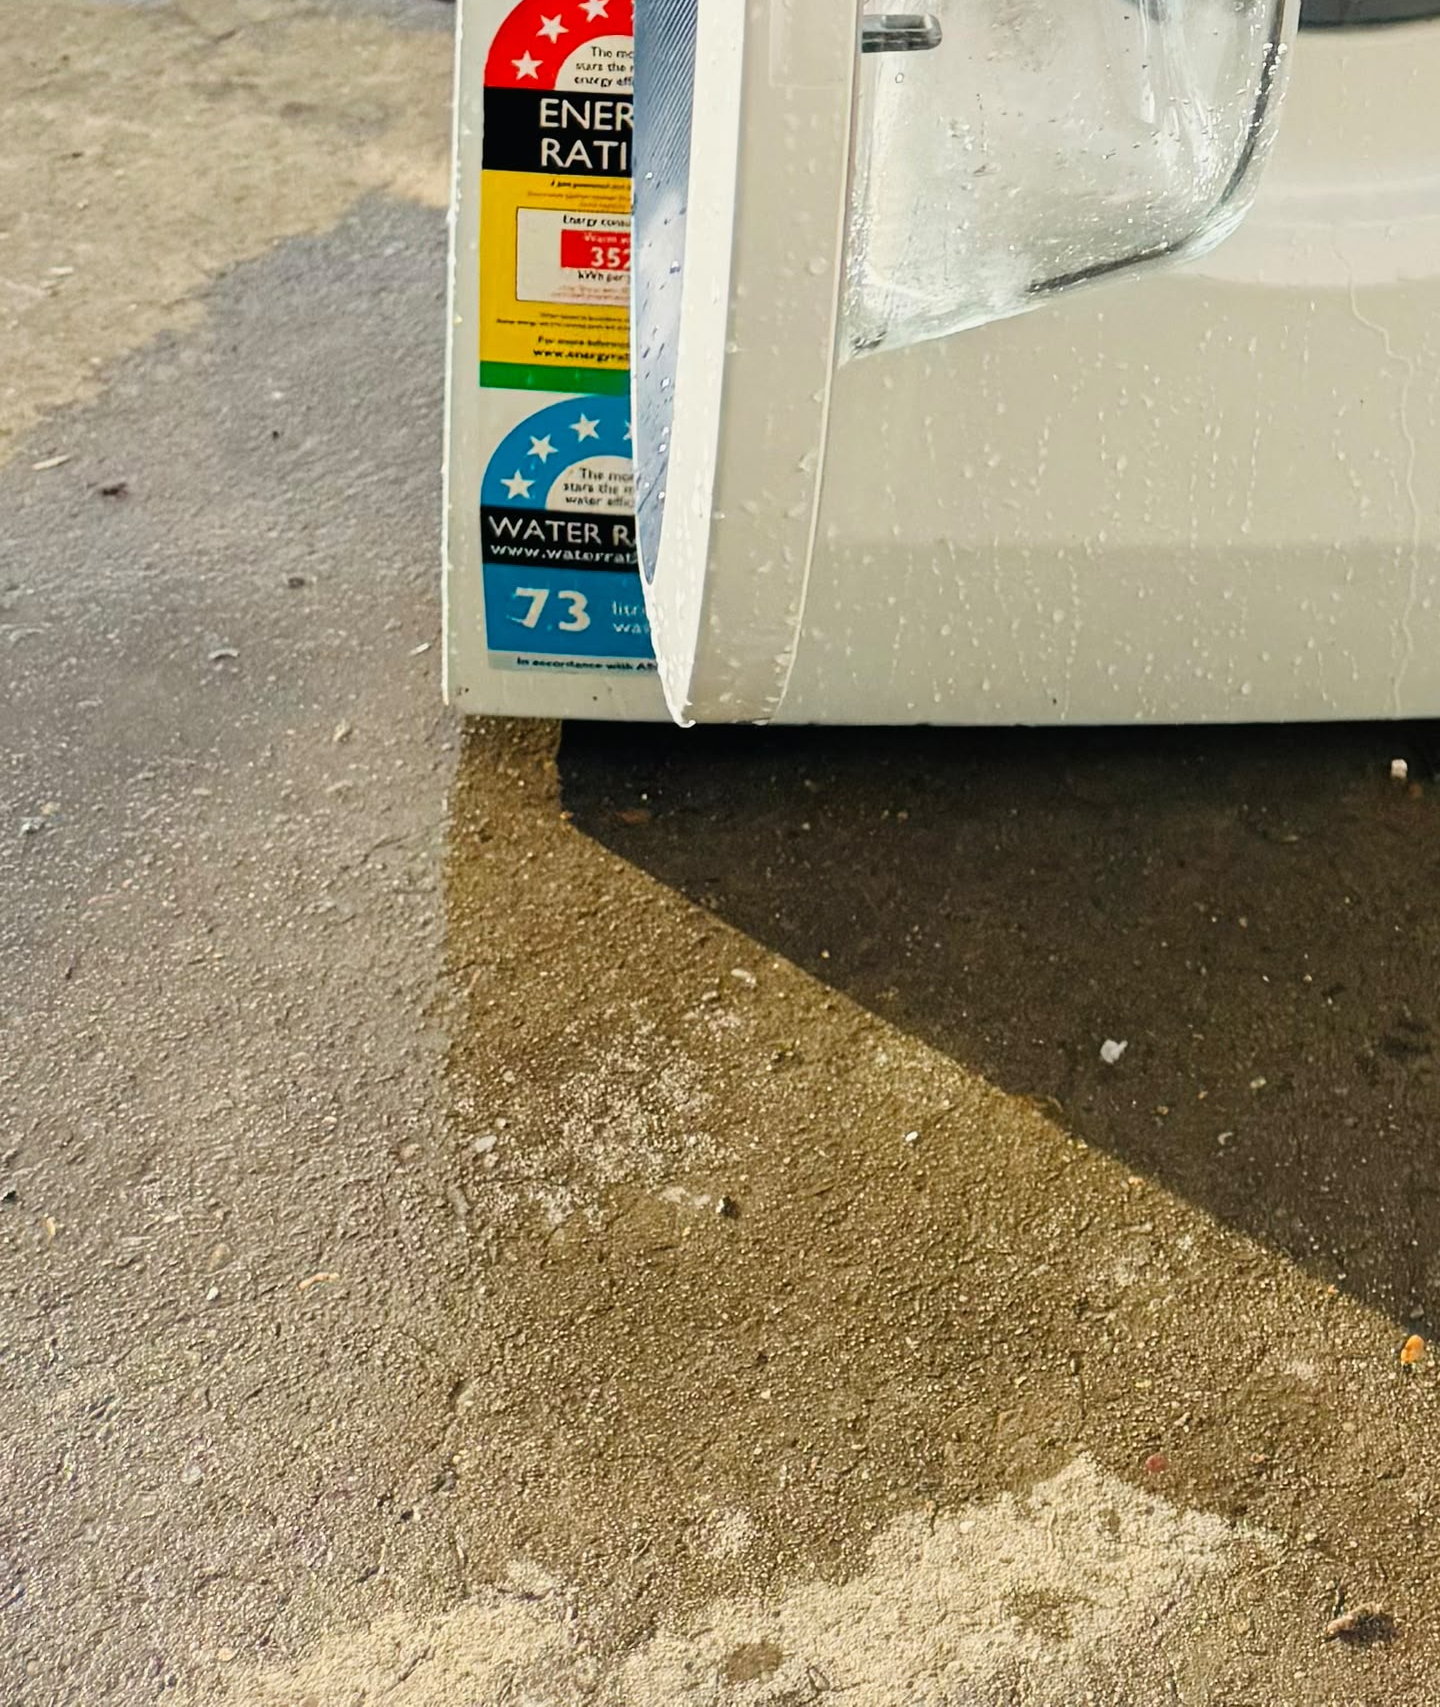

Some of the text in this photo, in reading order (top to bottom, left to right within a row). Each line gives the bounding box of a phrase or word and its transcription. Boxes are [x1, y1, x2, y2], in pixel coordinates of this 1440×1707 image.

[591, 46, 613, 58] The
[576, 61, 626, 72] stars the
[574, 76, 613, 87] energy
[563, 214, 598, 227] Energy
[578, 270, 624, 283] kWh per
[580, 467, 604, 481] The
[563, 482, 618, 494] stars the
[565, 496, 602, 506] water
[488, 515, 602, 546] WATER
[514, 587, 591, 632] 73
[612, 601, 646, 617] litr
[517, 655, 529, 666] In
[532, 658, 603, 669] accordance
[605, 661, 633, 671] with
